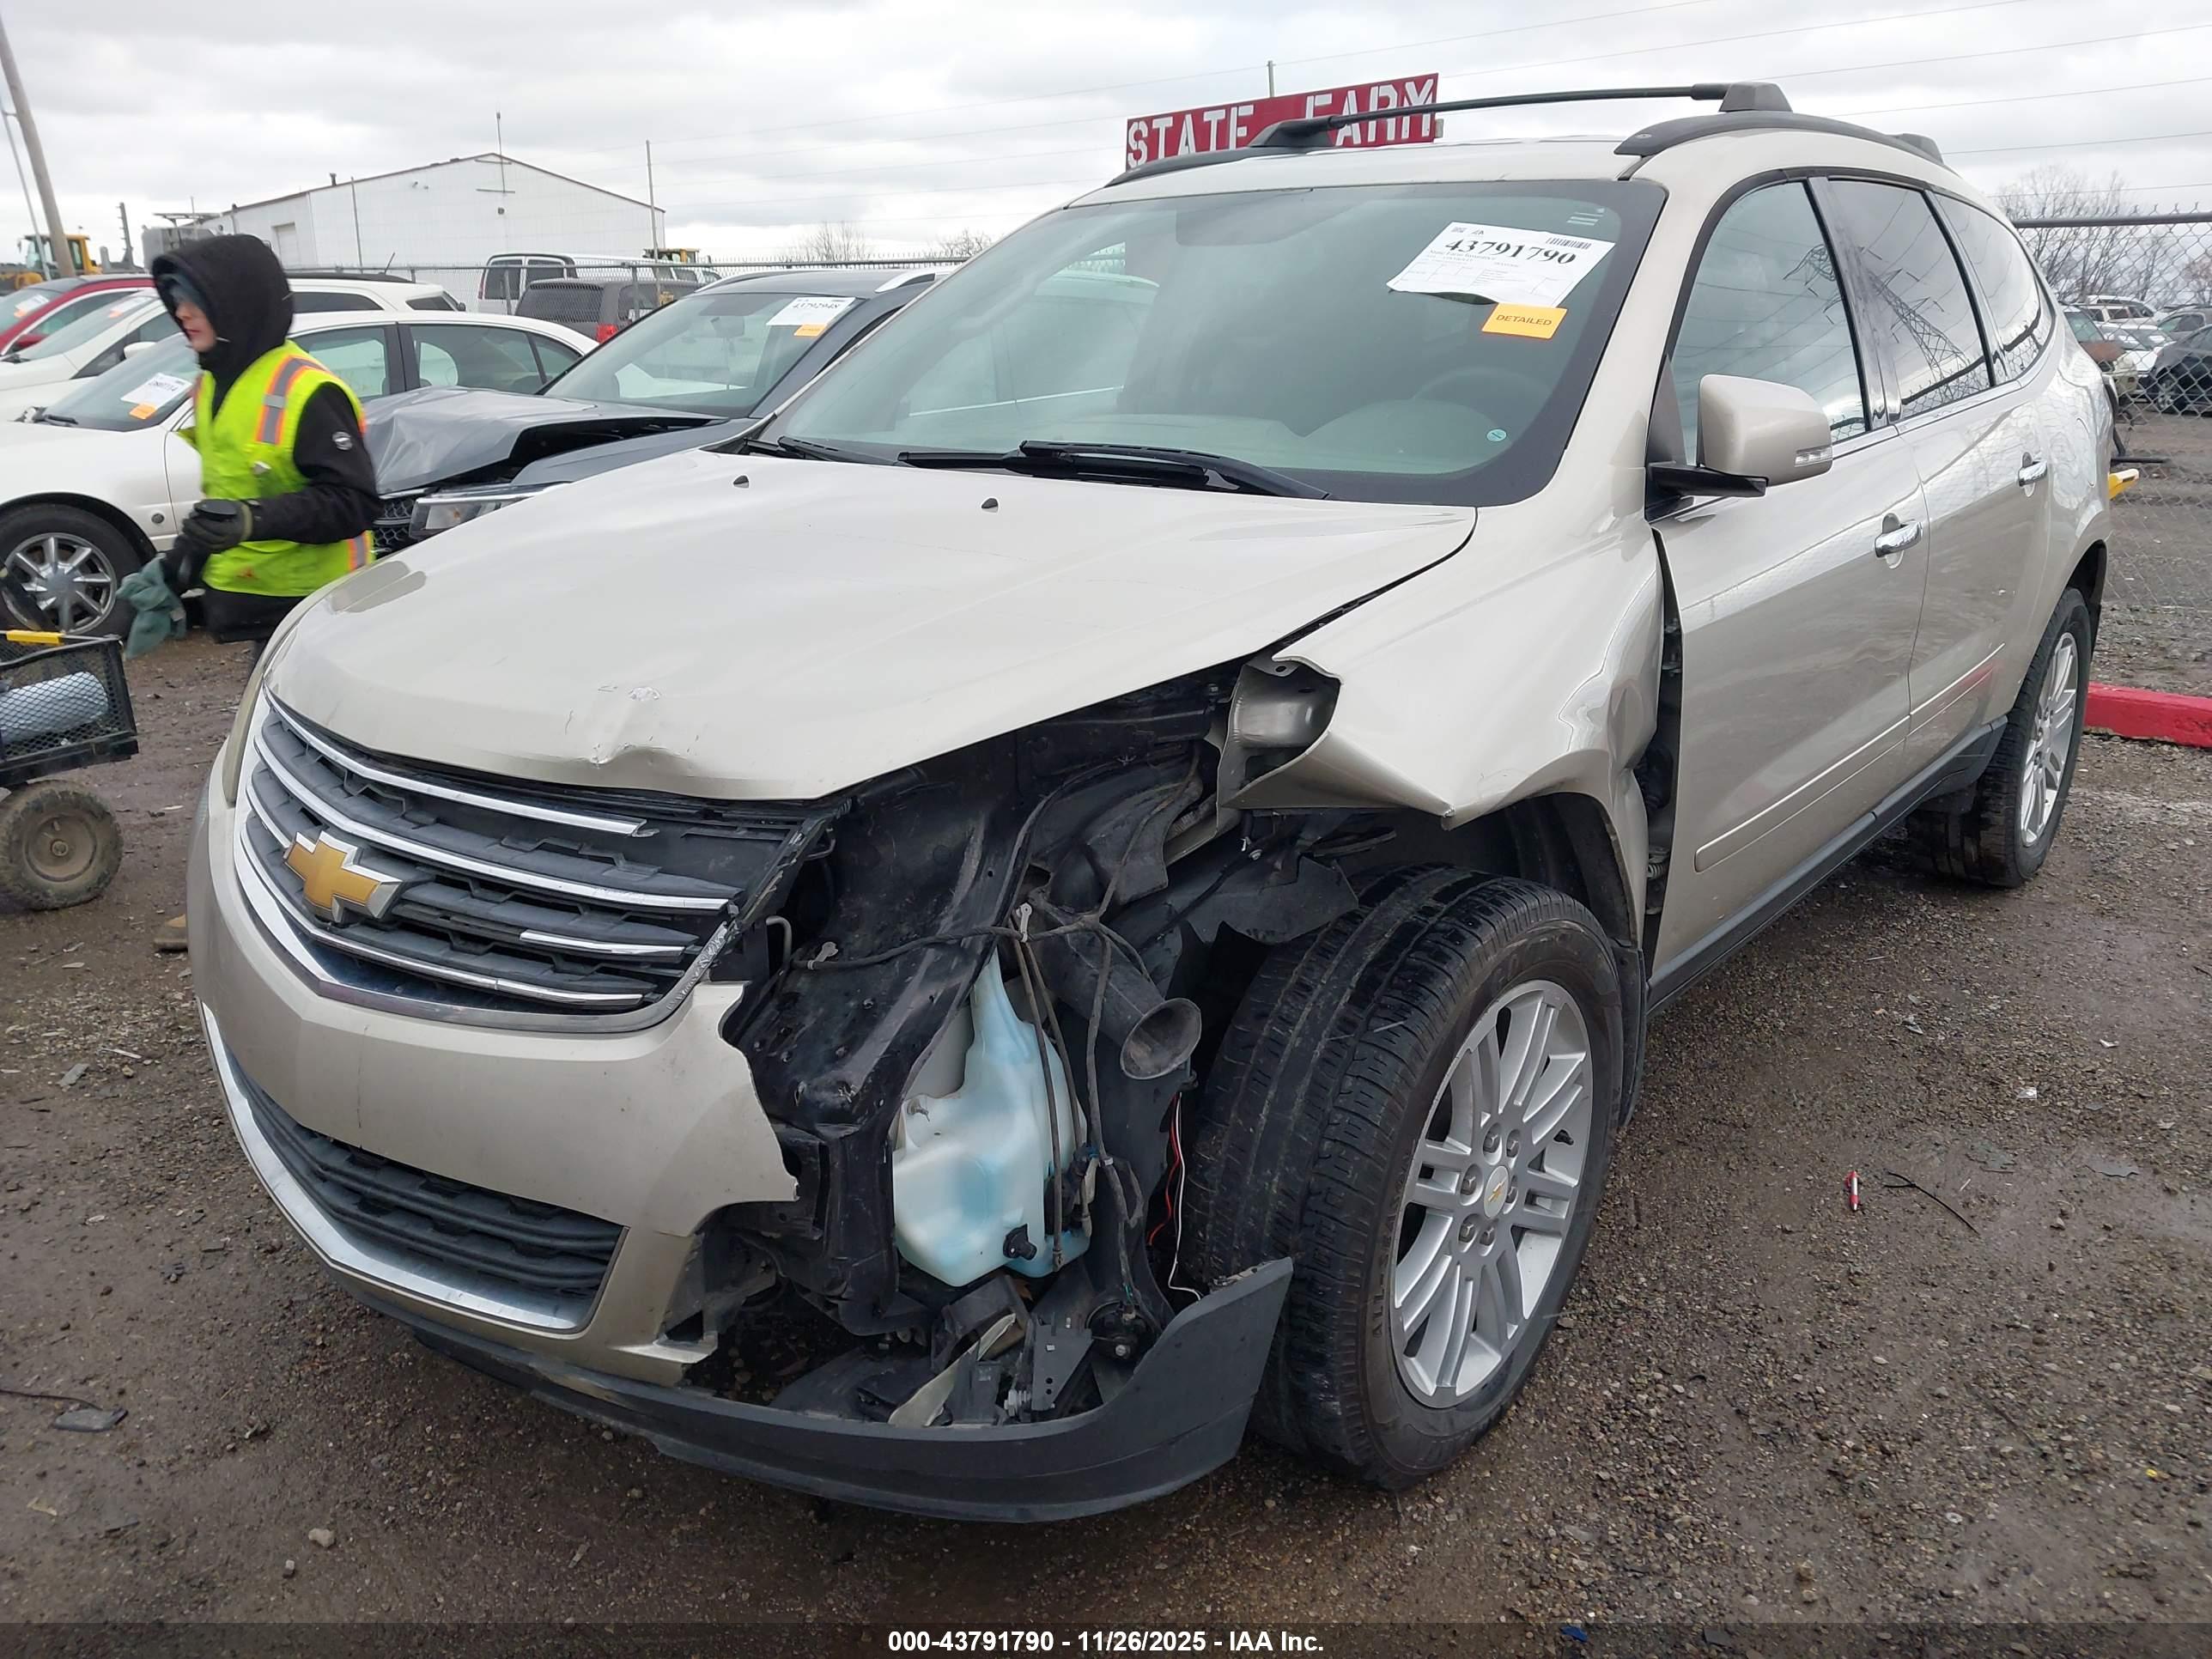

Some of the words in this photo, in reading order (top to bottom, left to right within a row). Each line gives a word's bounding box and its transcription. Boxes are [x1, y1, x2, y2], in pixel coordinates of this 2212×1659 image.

[1127, 104, 1255, 168] STATE
[1444, 238, 1577, 264] 43791790
[1496, 313, 1553, 327] DETAILED
